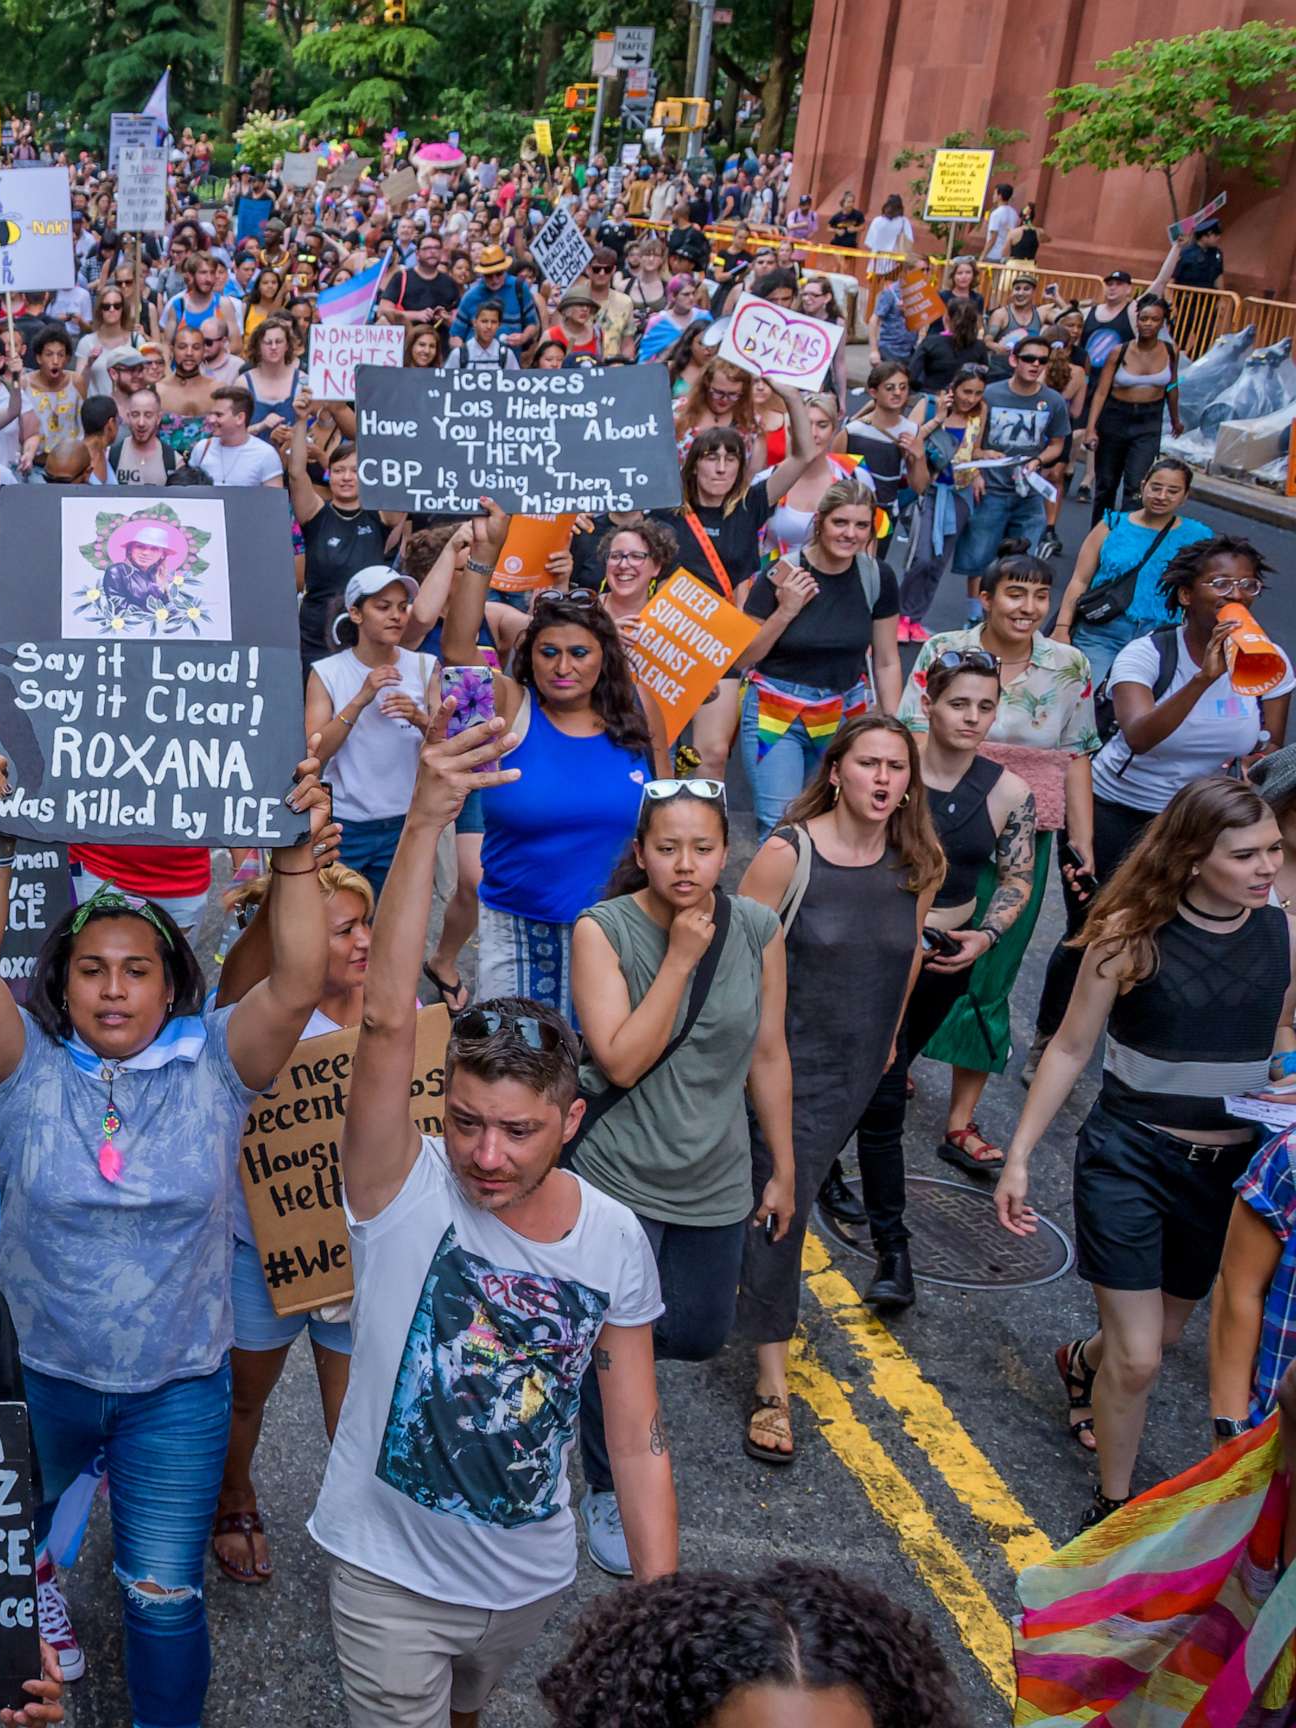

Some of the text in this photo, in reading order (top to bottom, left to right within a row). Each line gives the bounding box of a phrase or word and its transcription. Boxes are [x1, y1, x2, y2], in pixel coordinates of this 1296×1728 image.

[618, 42, 648, 51] TRAFFIC
[626, 32, 642, 40] ALL
[938, 161, 974, 169] Murder
[533, 208, 568, 257] TRANS
[542, 239, 566, 270] HEALTH
[549, 235, 582, 284] HUMAN
[743, 335, 808, 370] DYKES
[752, 315, 821, 357] TRANS
[312, 348, 399, 368] RIGHTS
[361, 409, 659, 442] Have You Heard About
[117, 469, 140, 482] BIG
[457, 441, 562, 475] THEM?
[358, 458, 649, 496] CBP Is Using Them To
[406, 488, 634, 514] Tortur Migrants
[669, 575, 720, 621] QUEER
[631, 622, 697, 677] AGAINST
[649, 598, 732, 667] SURVIVORS
[12, 641, 260, 689] Say it Loud!
[13, 679, 265, 738] Say it Clear!
[50, 726, 255, 791] ROXANA
[65, 787, 157, 830] Killed
[171, 789, 208, 840] by
[223, 795, 282, 839] ICE
[5, 898, 47, 932] CE
[290, 1052, 354, 1089] nee
